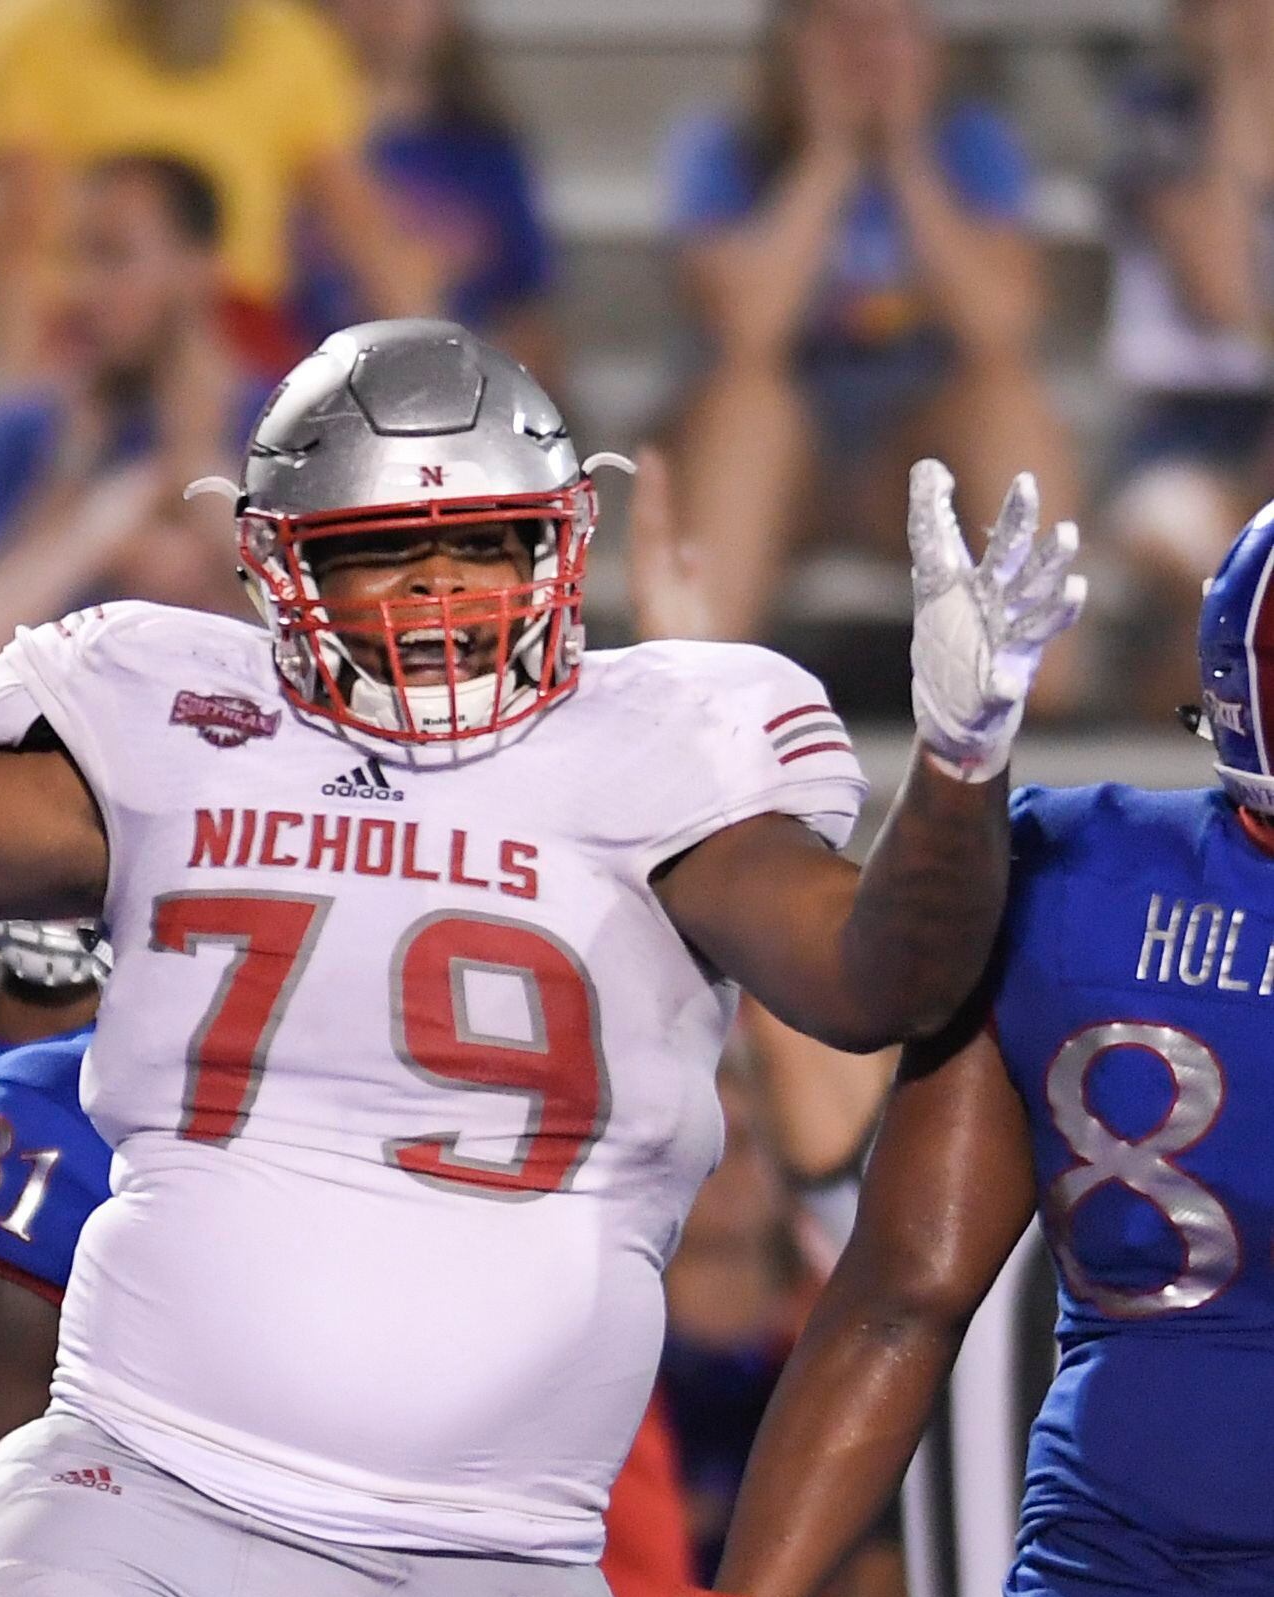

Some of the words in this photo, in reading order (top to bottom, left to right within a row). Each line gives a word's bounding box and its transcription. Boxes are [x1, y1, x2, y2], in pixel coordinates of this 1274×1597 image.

[420, 466, 443, 487] N
[321, 783, 405, 801] adidas
[186, 809, 539, 900] NICHOLLS
[148, 888, 613, 1203] 79
[1044, 1020, 1241, 1321] 8
